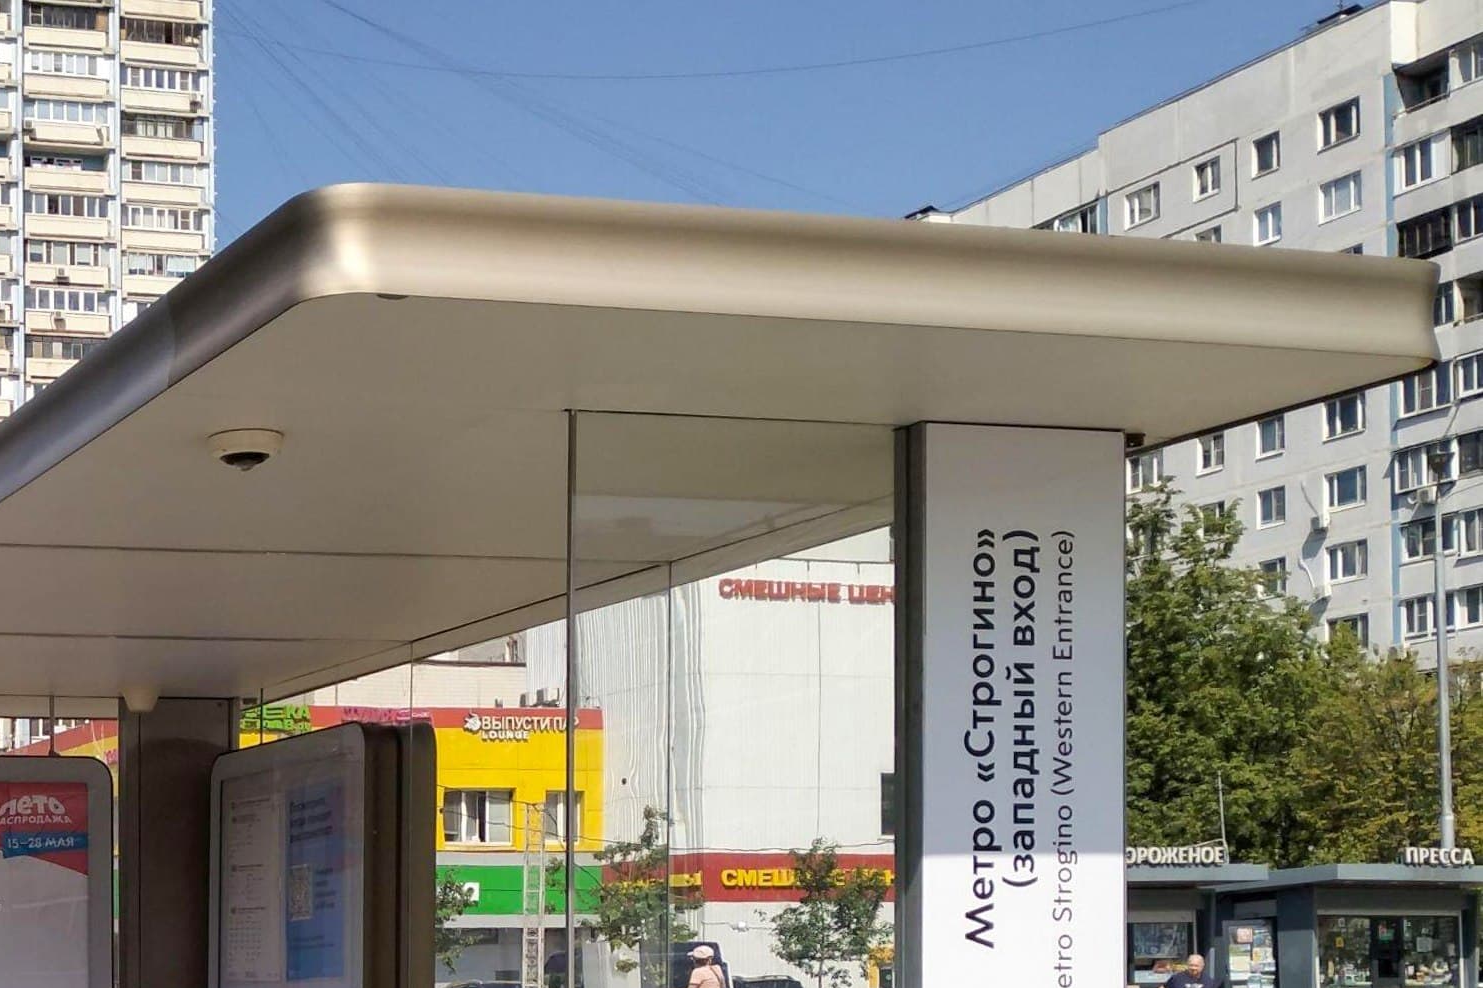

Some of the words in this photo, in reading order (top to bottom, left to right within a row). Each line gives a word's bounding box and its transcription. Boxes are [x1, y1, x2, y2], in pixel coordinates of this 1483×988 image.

[719, 578, 842, 604] СМЕШНЫЕ
[848, 583, 895, 605] ЦЕН
[1002, 529, 1041, 646] вход)
[1050, 530, 1075, 660] Entrance)
[963, 528, 1003, 783] «Строгино»
[481, 715, 551, 731] ВЫПУСТИ
[481, 730, 530, 741] LOUNGE
[1002, 661, 1040, 888] (западный
[1050, 671, 1075, 796] (Western
[45, 836, 75, 848] МАЯ
[964, 799, 1003, 949] Метро
[1052, 804, 1078, 922] Strogino
[1125, 846, 1225, 865] ОРОЖЕНОЕ
[1405, 846, 1475, 865] ПРЕССА
